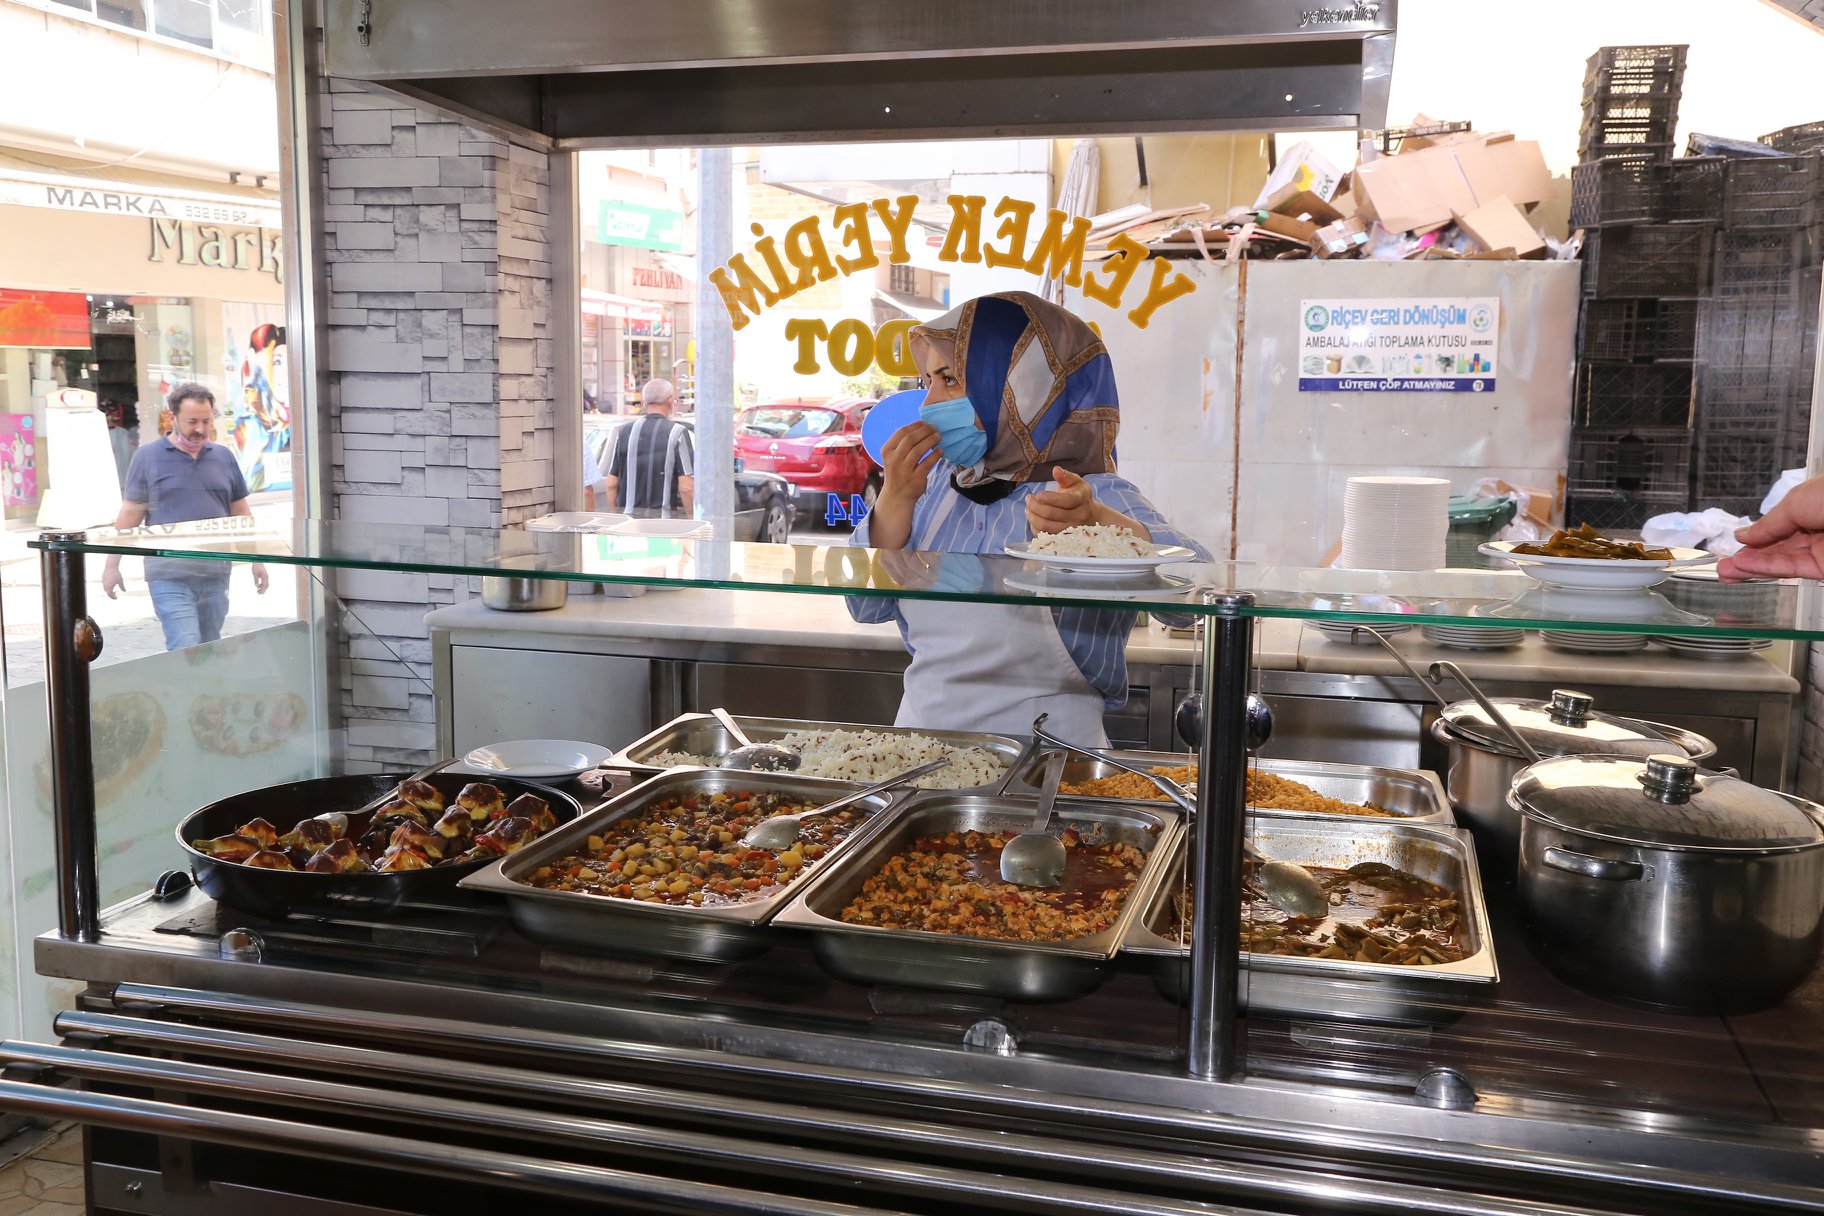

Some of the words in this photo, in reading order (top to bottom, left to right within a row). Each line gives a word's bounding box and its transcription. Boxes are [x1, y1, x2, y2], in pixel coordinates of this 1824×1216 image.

[46, 187, 168, 215] MARKA
[185, 205, 210, 218] 532
[1331, 306, 1368, 329] RİÇEV
[1370, 307, 1400, 326] GERİ
[1403, 305, 1467, 329] DÖNÜŞÜM
[1305, 336, 1350, 348] AMBALAJ
[1380, 336, 1425, 348] TOPLAMA
[1428, 335, 1467, 348] KUTUSU
[1339, 380, 1377, 390] LÜTFEN
[1402, 380, 1455, 390] ATMAYINIZ
